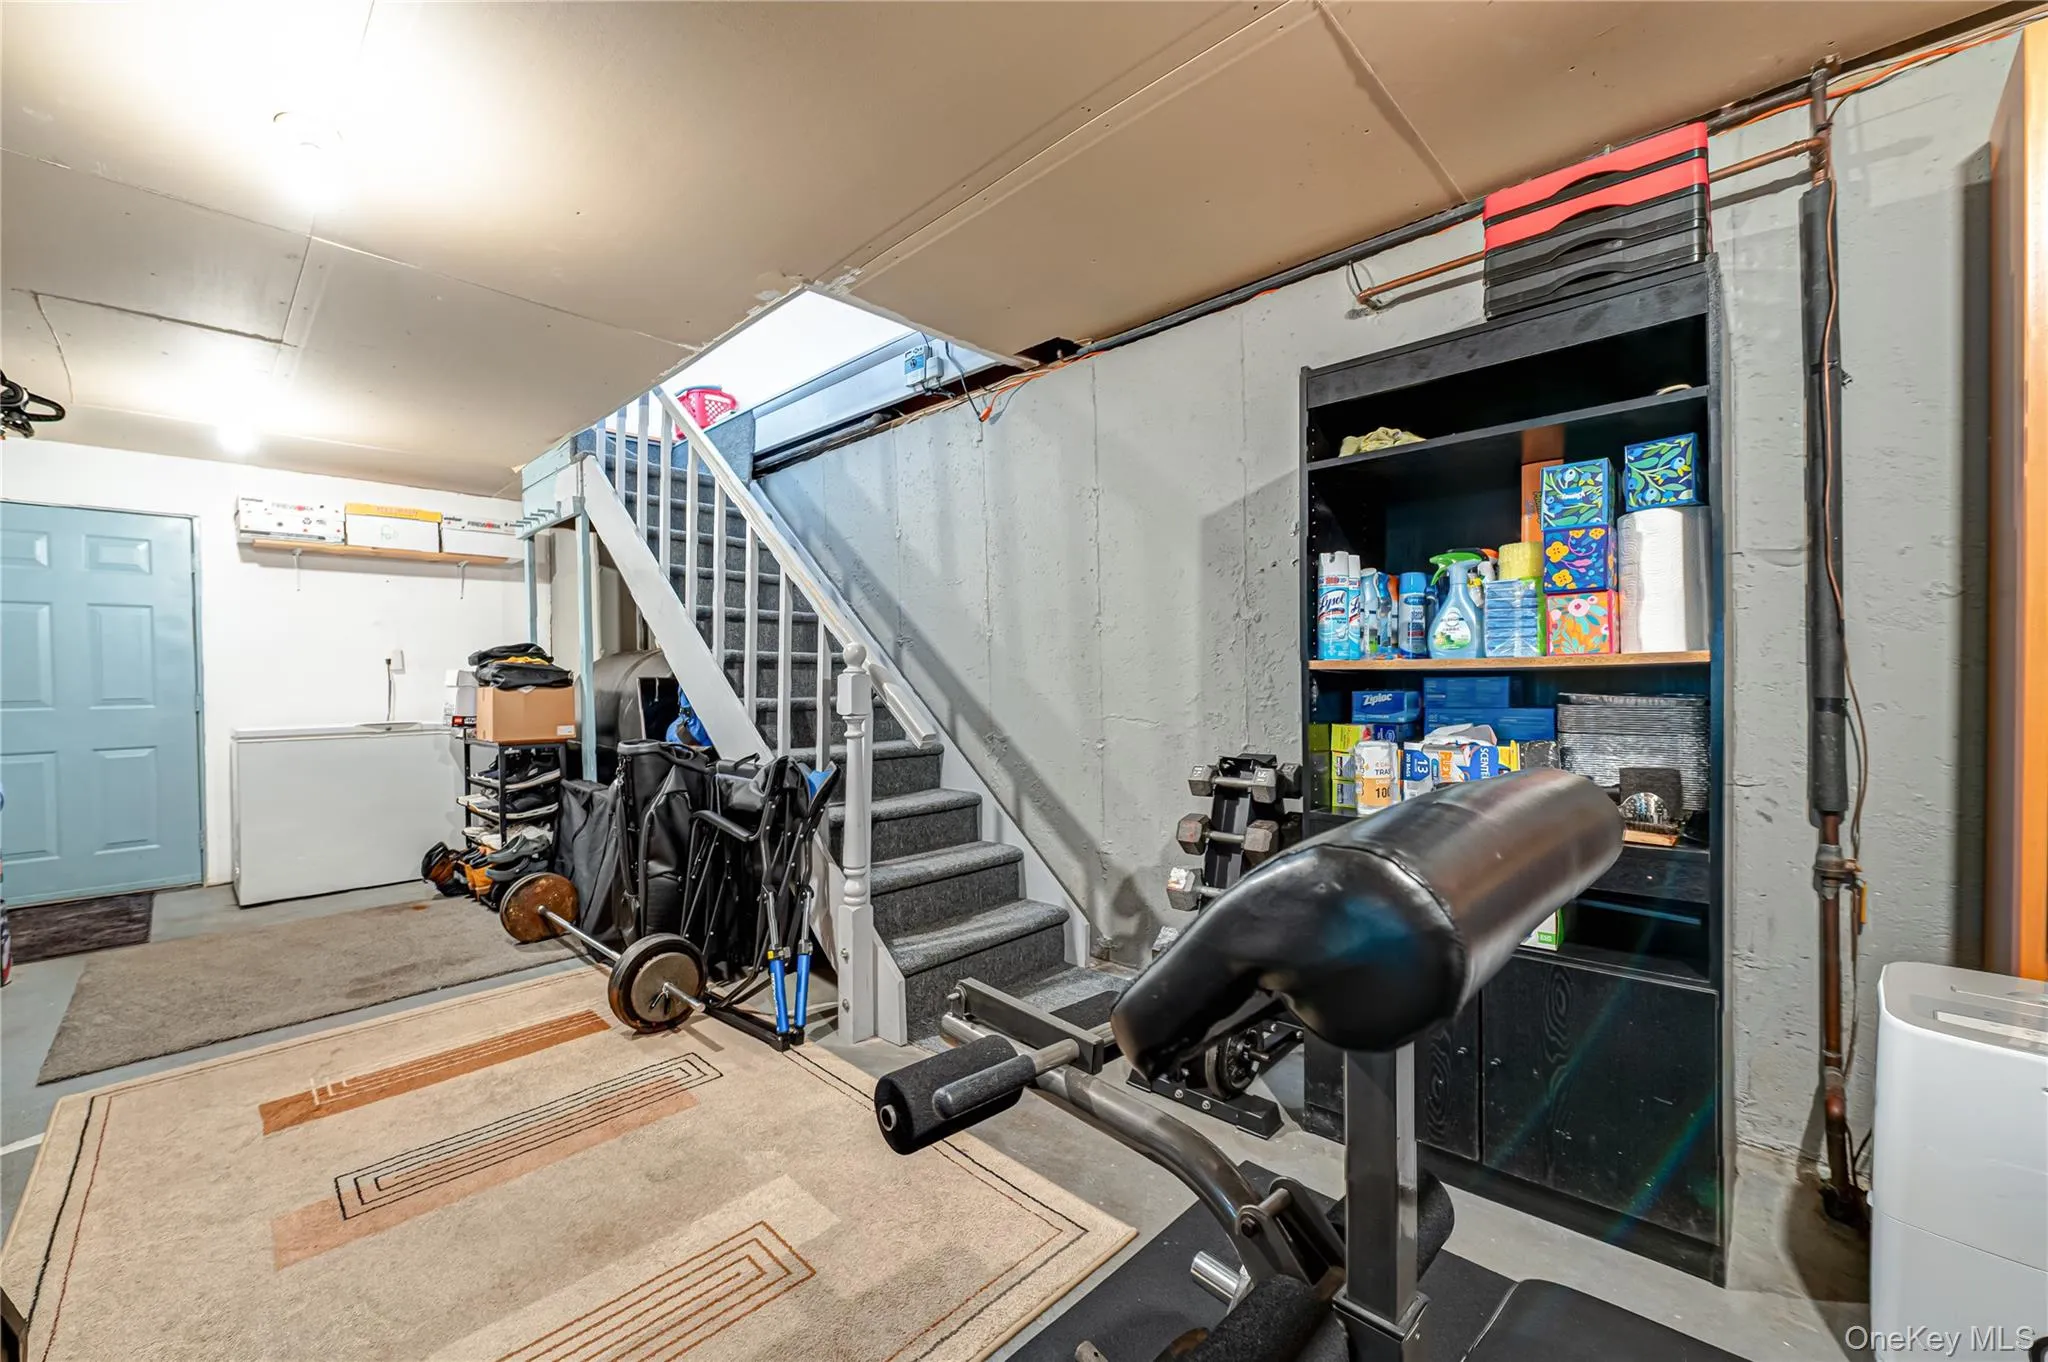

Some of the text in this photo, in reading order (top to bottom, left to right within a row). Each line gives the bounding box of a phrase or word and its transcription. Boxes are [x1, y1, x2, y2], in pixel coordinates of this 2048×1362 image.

[1319, 592, 1345, 612] Lysol
[1362, 692, 1393, 706] Ziploc
[1417, 759, 1428, 774] 13
